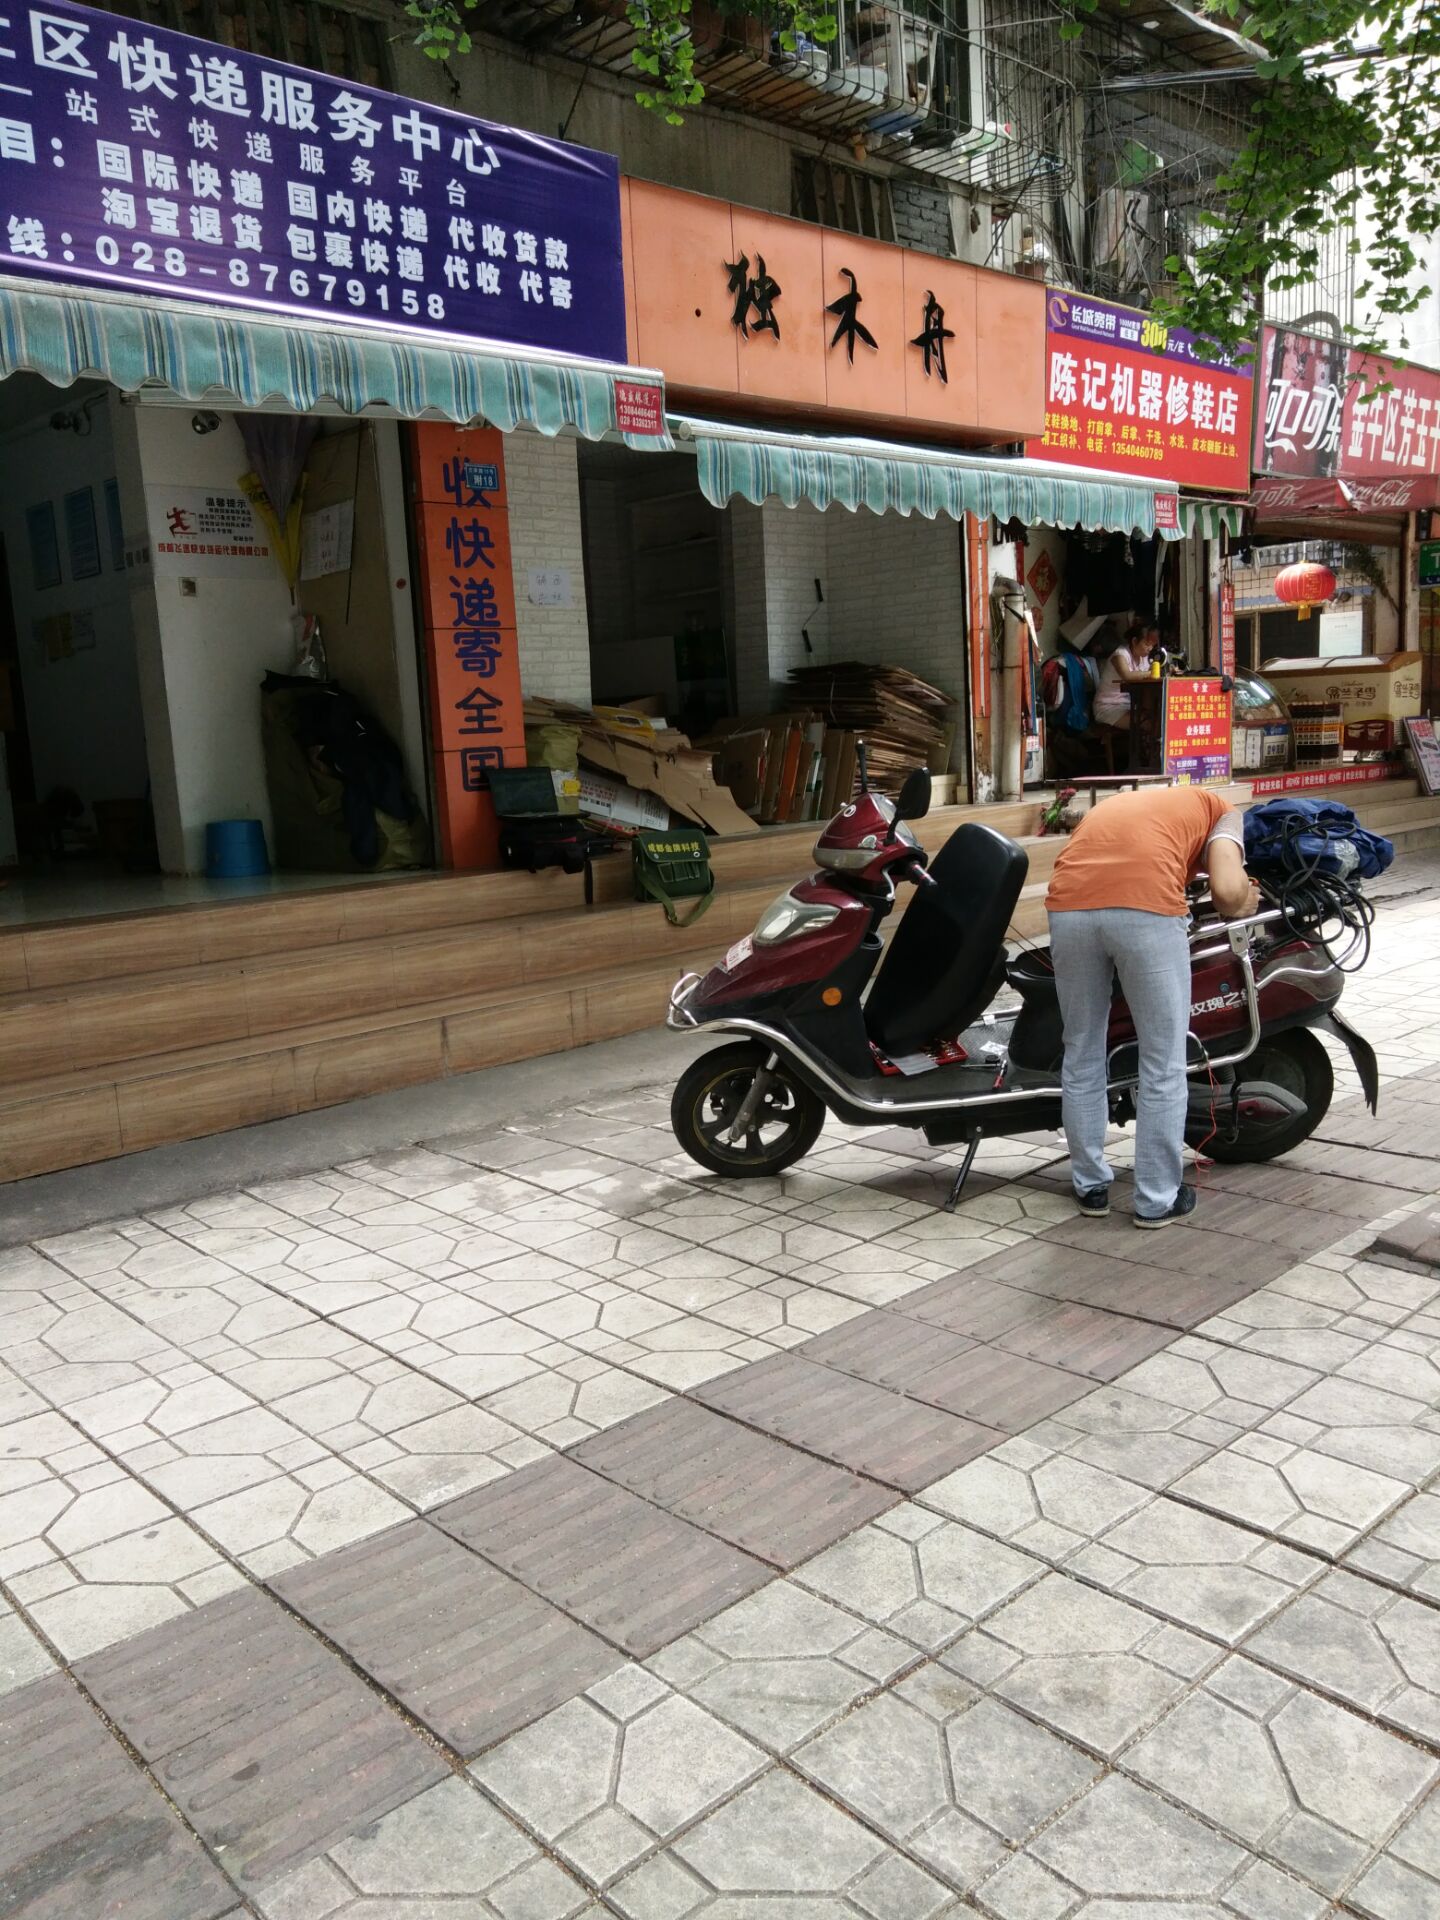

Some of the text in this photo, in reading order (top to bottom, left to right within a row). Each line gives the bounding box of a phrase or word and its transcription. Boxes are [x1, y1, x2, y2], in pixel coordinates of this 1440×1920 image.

[0, 10, 500, 176] 区快递服务中心
[96, 139, 264, 210] 国际快递
[287, 181, 428, 243] 国内快递
[448, 216, 569, 271] 代收货款
[101, 186, 573, 309] 淘宝退货 包裹快递 代收 代寄
[723, 249, 956, 385] 独木舟
[1071, 304, 1117, 332] 长城宽带
[1050, 351, 1239, 436] 陈记机器修鞋店
[1265, 378, 1345, 454] 可口可乐
[443, 456, 505, 793] 收快递寄全国
